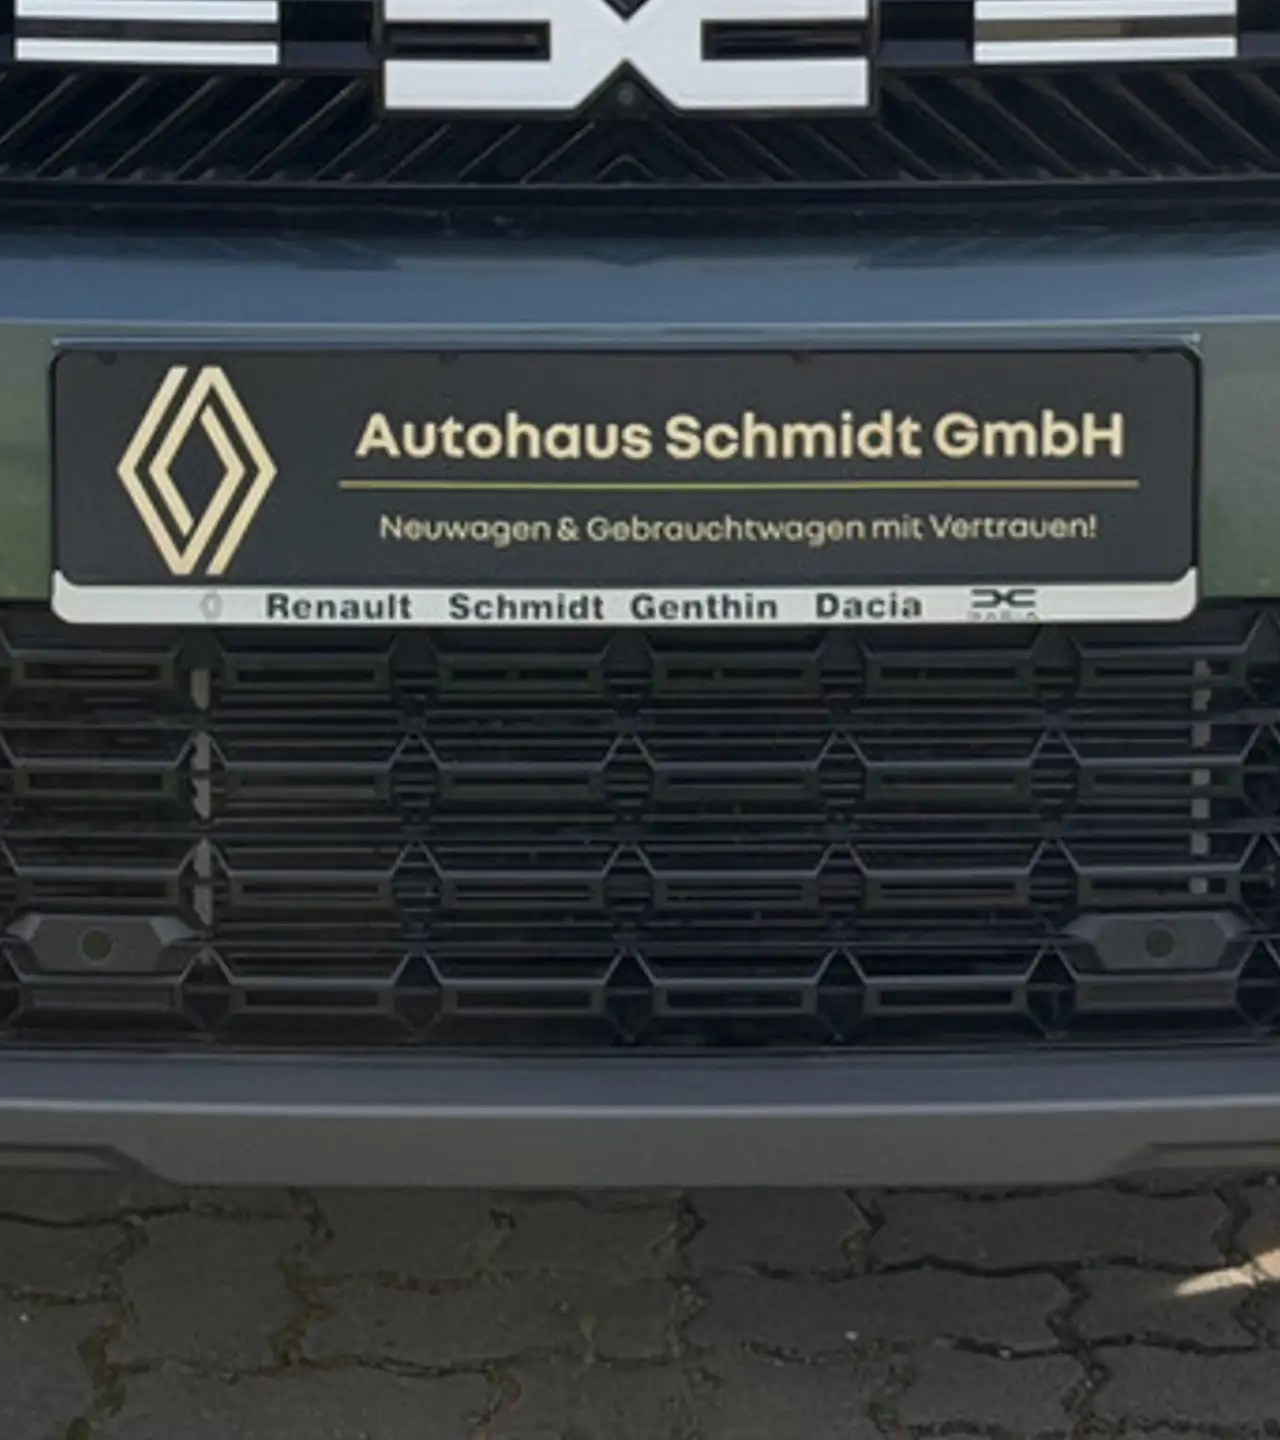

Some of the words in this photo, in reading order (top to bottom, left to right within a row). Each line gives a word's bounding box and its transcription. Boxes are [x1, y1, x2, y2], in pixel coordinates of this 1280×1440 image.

[355, 411, 653, 460] Autohaus
[665, 410, 922, 459] Schmidt
[933, 409, 1124, 458] GmbH
[379, 514, 552, 549] Neuwagen
[556, 515, 581, 542] &
[587, 513, 866, 549] Gebrauchtwagen
[871, 513, 922, 541] mit
[928, 513, 1098, 541] Vertrauen!
[266, 592, 412, 621] Renault
[448, 592, 605, 621] Schmidt
[630, 592, 778, 621] Genthin
[815, 591, 923, 620] Dacia
